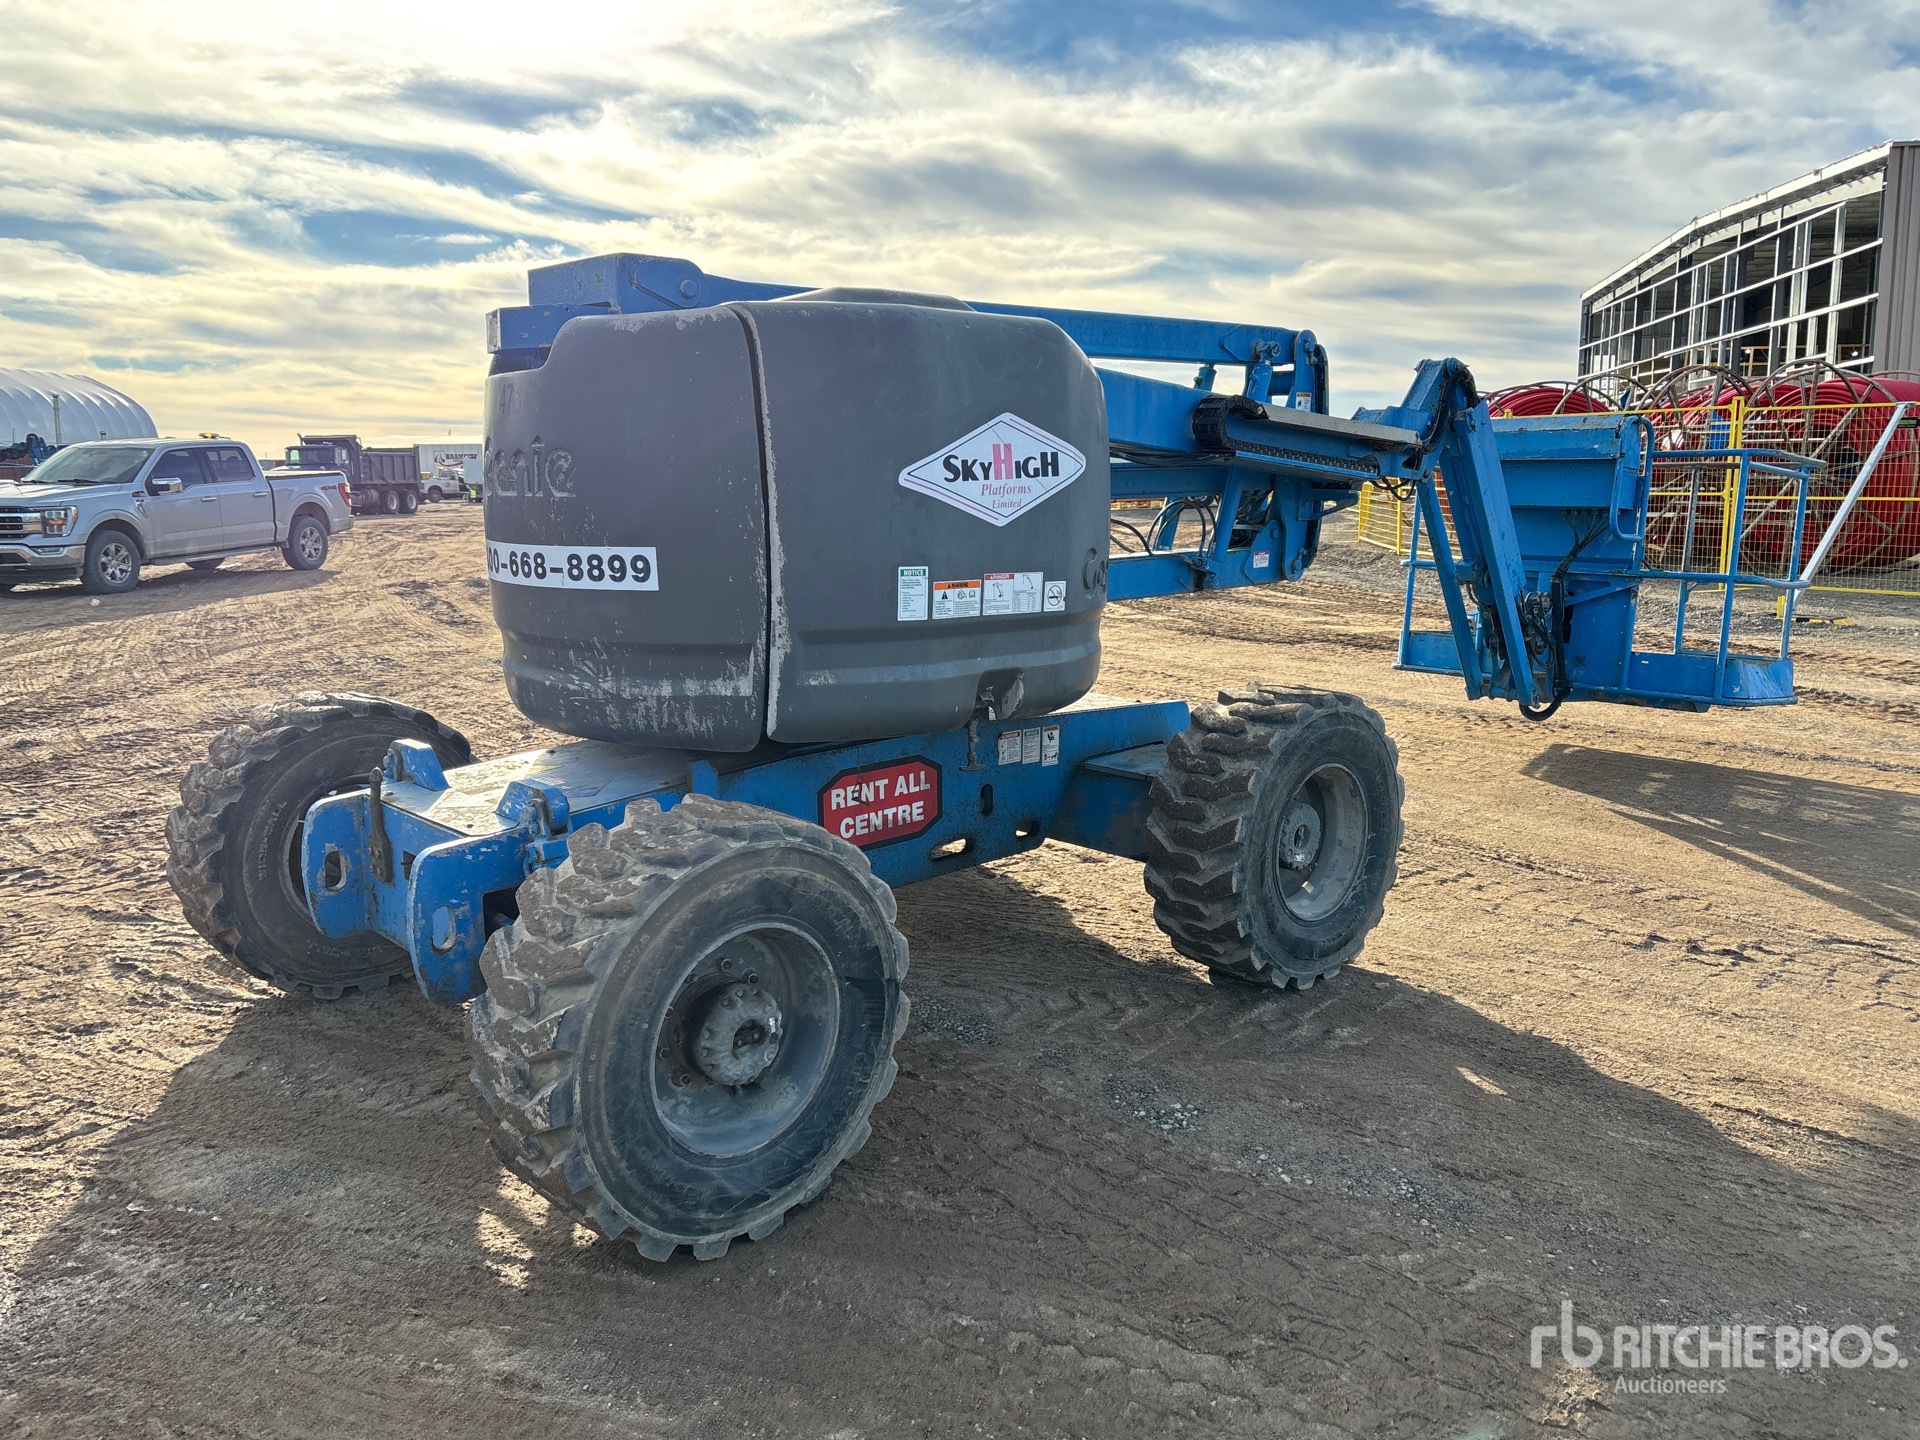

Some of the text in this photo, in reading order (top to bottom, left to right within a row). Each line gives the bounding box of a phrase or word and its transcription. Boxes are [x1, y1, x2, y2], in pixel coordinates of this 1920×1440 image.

[980, 483, 1032, 498] Platforms
[991, 499, 1022, 509] Limited
[831, 770, 931, 811] RENT ALL
[840, 800, 925, 839] CENTRE
